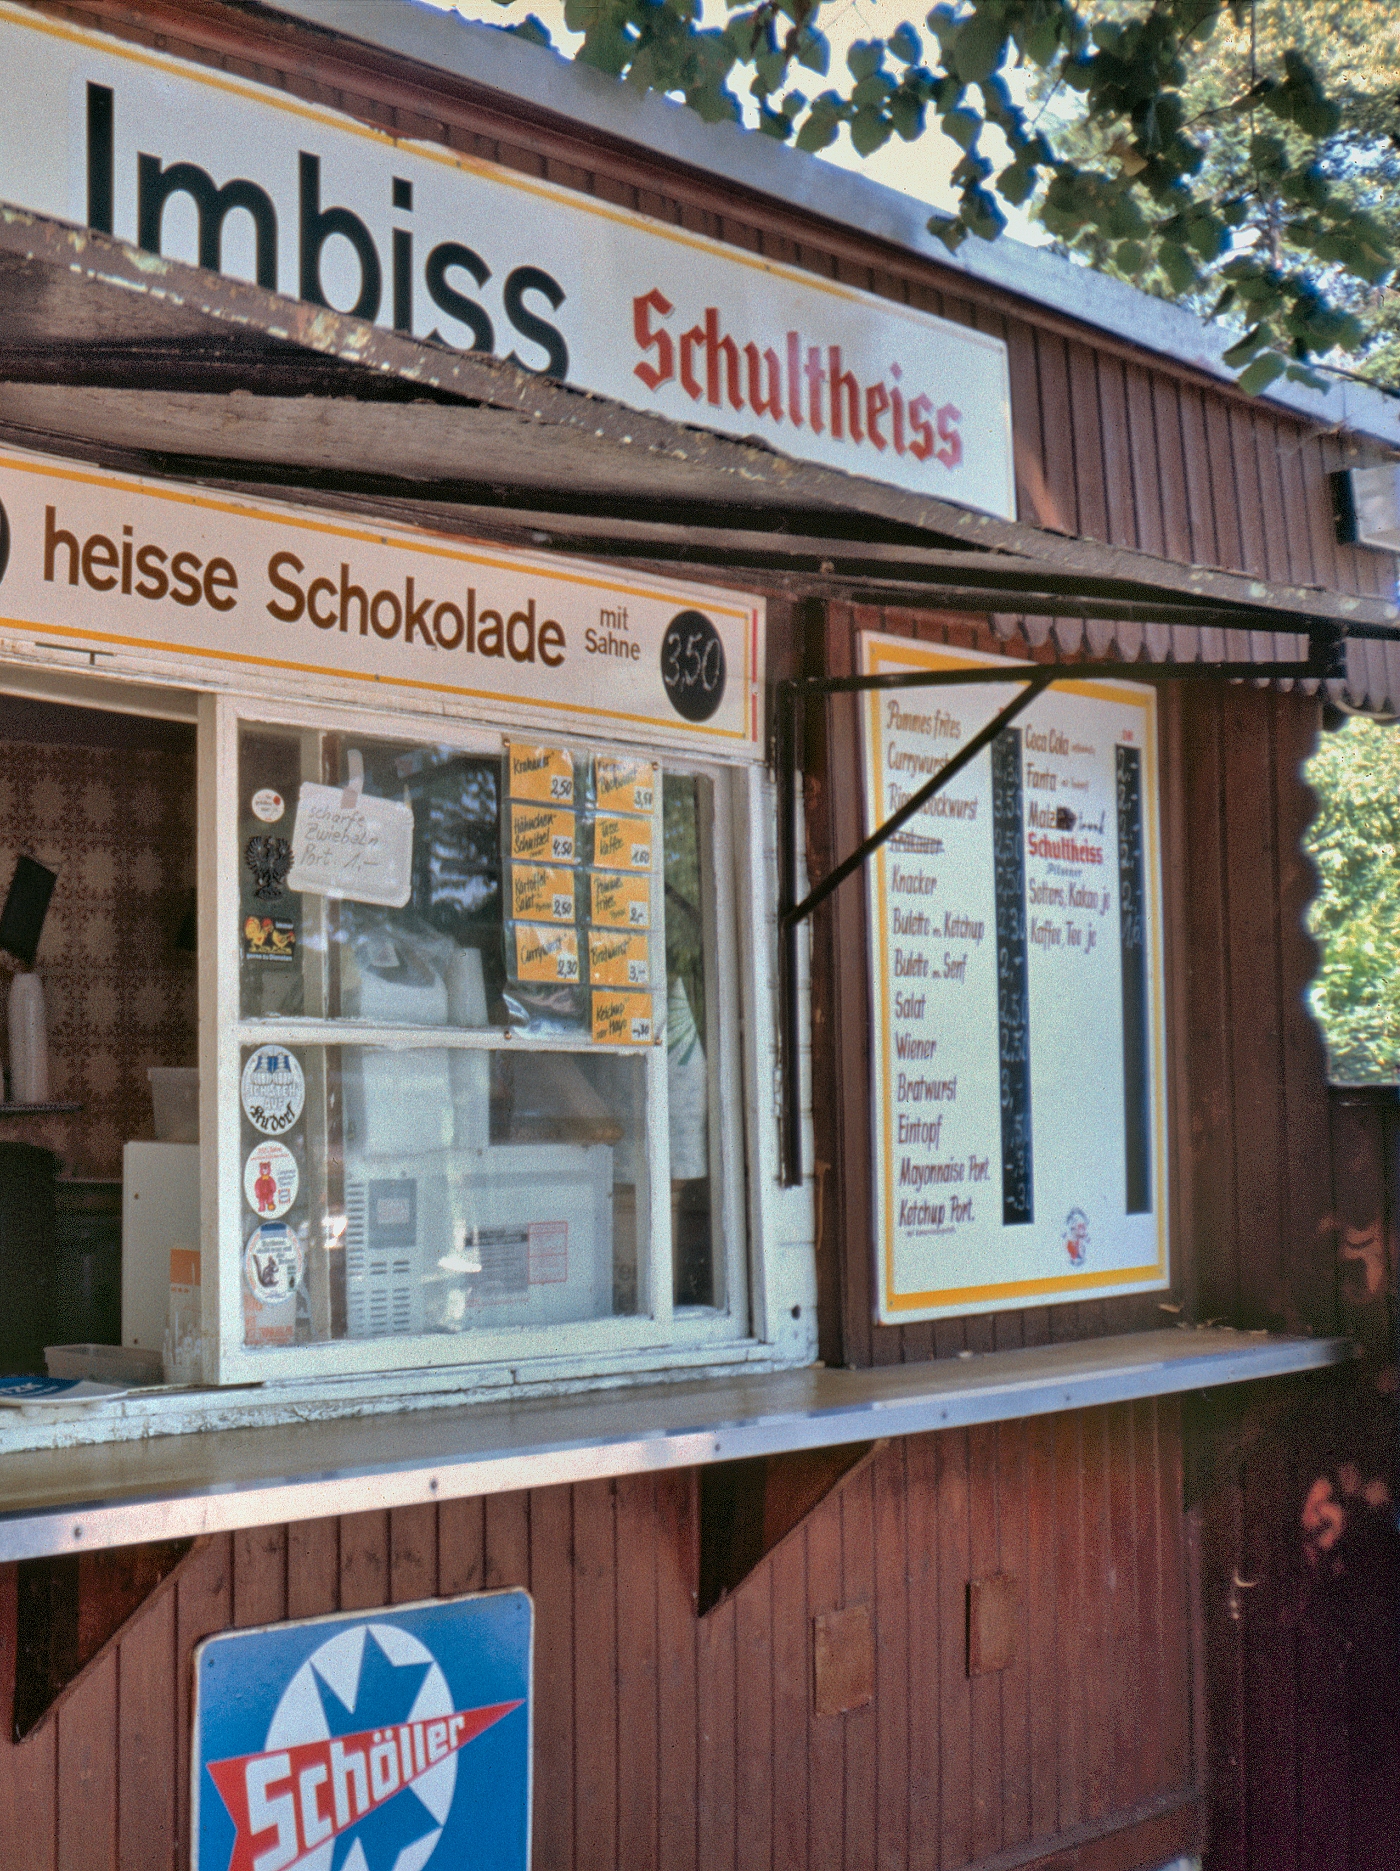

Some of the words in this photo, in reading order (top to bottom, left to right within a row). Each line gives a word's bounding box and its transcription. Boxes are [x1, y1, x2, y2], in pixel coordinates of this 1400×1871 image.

[86, 80, 569, 380] Imbiss
[633, 287, 963, 470] Schultheiss
[43, 504, 239, 612] heisse
[266, 551, 567, 668] Schokolade
[600, 605, 629, 631] mit
[584, 628, 641, 660] Sahne
[887, 699, 932, 735] Pommes
[1025, 723, 1047, 752] Coca
[1048, 728, 1070, 756] Cola
[1027, 761, 1057, 792] Fanta
[1028, 831, 1104, 865] Schultheiss
[891, 864, 938, 897] Knacker
[893, 907, 930, 937] Bulette
[944, 911, 985, 947] Ketchup
[894, 949, 929, 979] Bulette
[943, 952, 967, 985] Senf
[895, 991, 926, 1021] Salat
[896, 1031, 937, 1061] Wiener
[897, 1073, 957, 1103] Bratwurst
[898, 1113, 943, 1152] Eintopf
[899, 1155, 965, 1192] Mayonnaise
[899, 1197, 945, 1229] Ketchup
[245, 1715, 465, 1871] Schöller
